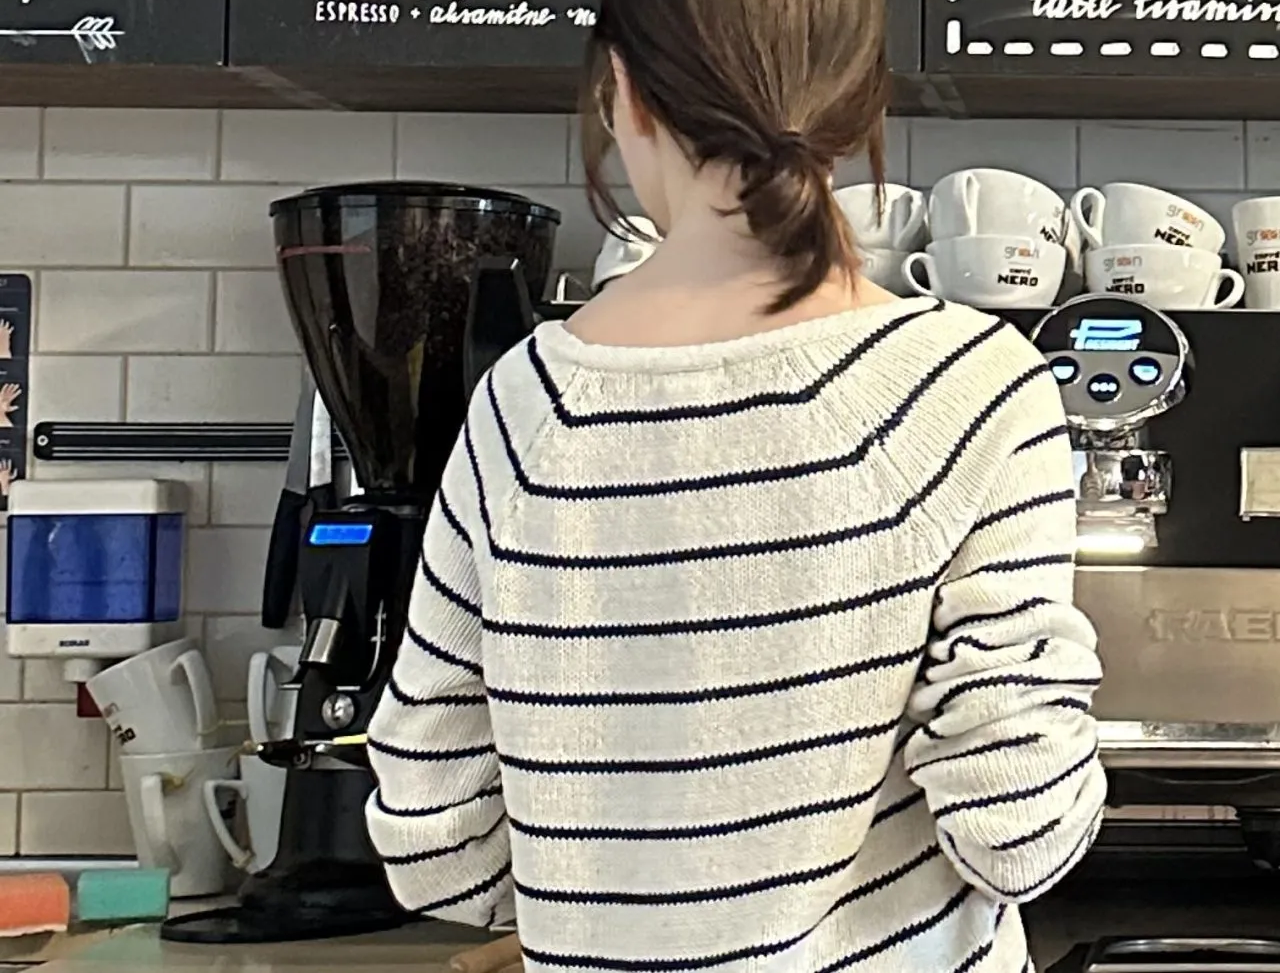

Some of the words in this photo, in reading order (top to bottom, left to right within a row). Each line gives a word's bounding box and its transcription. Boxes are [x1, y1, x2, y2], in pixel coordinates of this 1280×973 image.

[316, 1, 399, 23] ESPRESSO
[430, 2, 555, 25] aksamitne
[997, 273, 1039, 287] NERO
